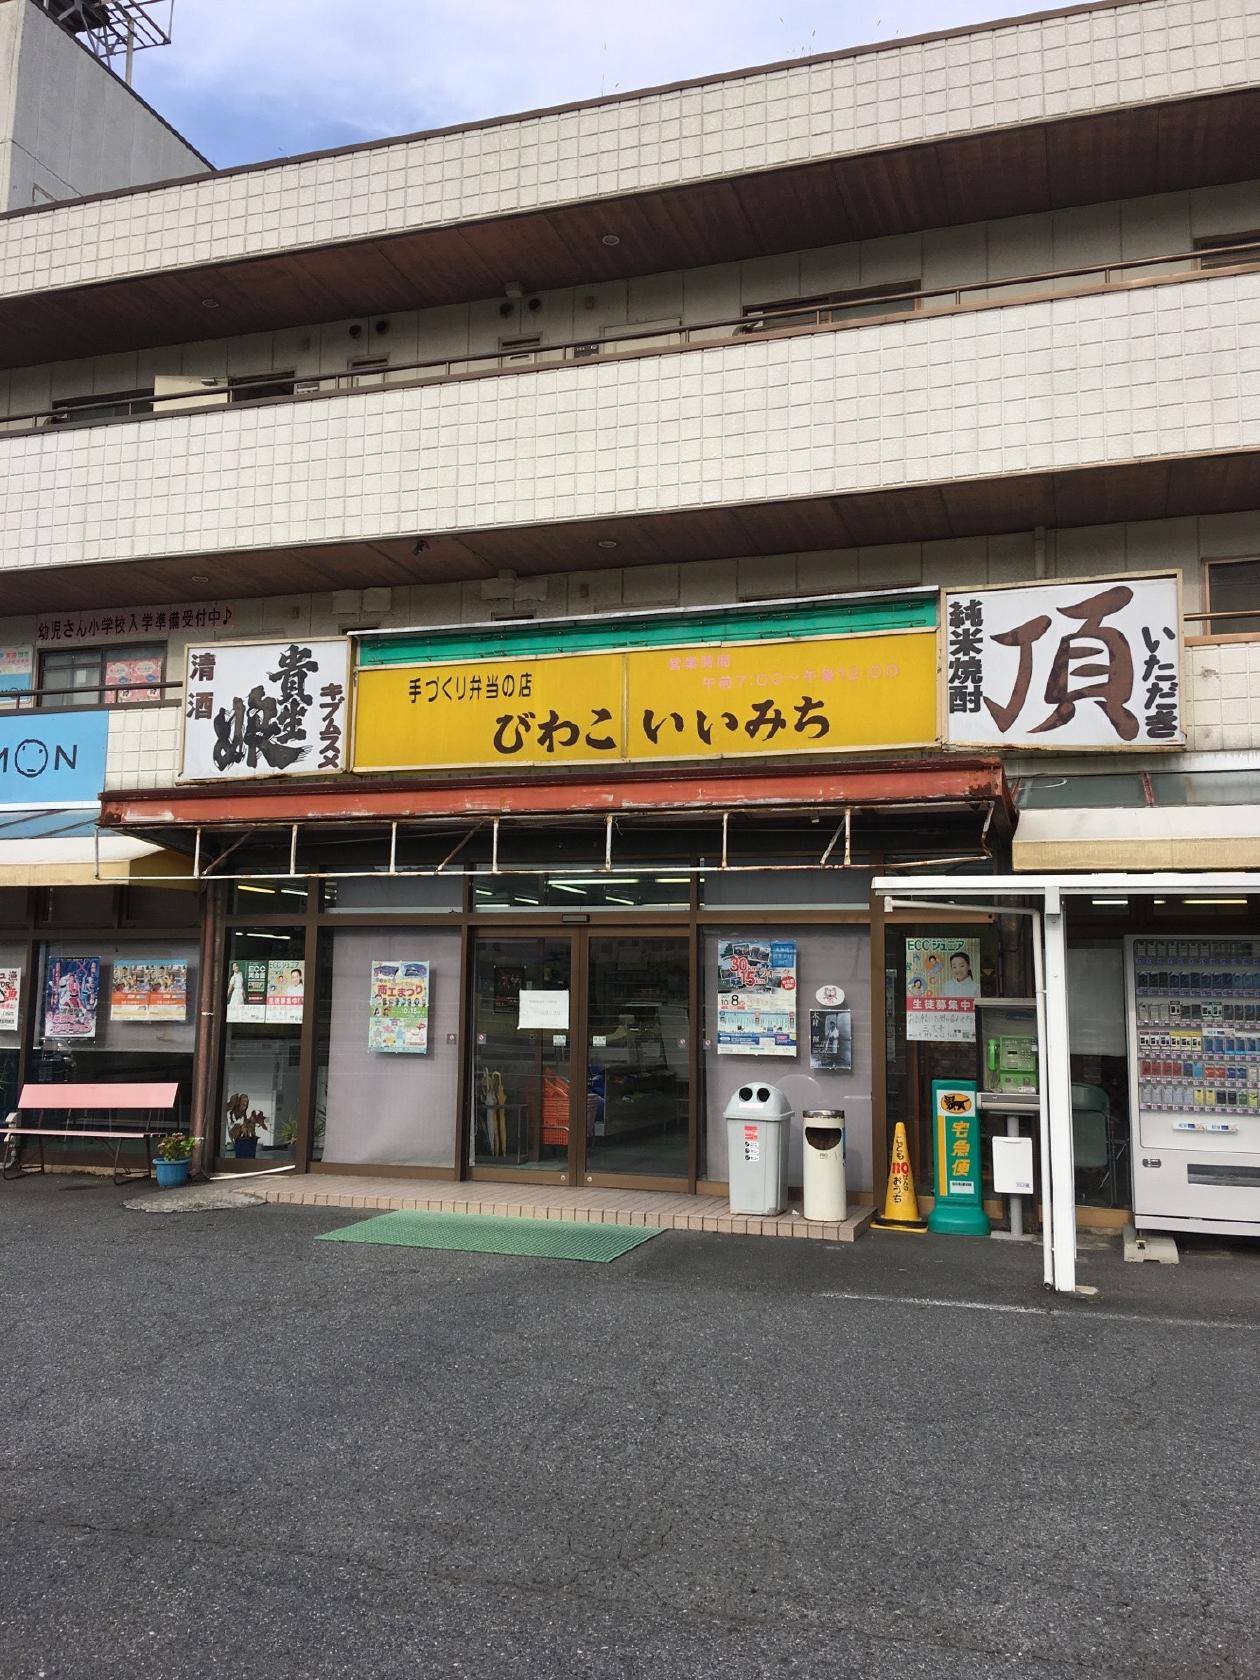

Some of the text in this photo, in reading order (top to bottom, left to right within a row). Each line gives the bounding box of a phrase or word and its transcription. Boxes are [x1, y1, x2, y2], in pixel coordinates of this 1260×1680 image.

[948, 599, 984, 714] 純米焼酎
[983, 586, 1140, 741] 頂
[1142, 626, 1179, 739] いただき
[185, 651, 216, 721] 清酒
[408, 672, 533, 704] 手づくり弁当の店
[493, 696, 830, 754] びわこ いいみち
[907, 940, 965, 952] ECCジュニア
[892, 1162, 909, 1174] 110
[952, 1120, 971, 1177] 宅急便
